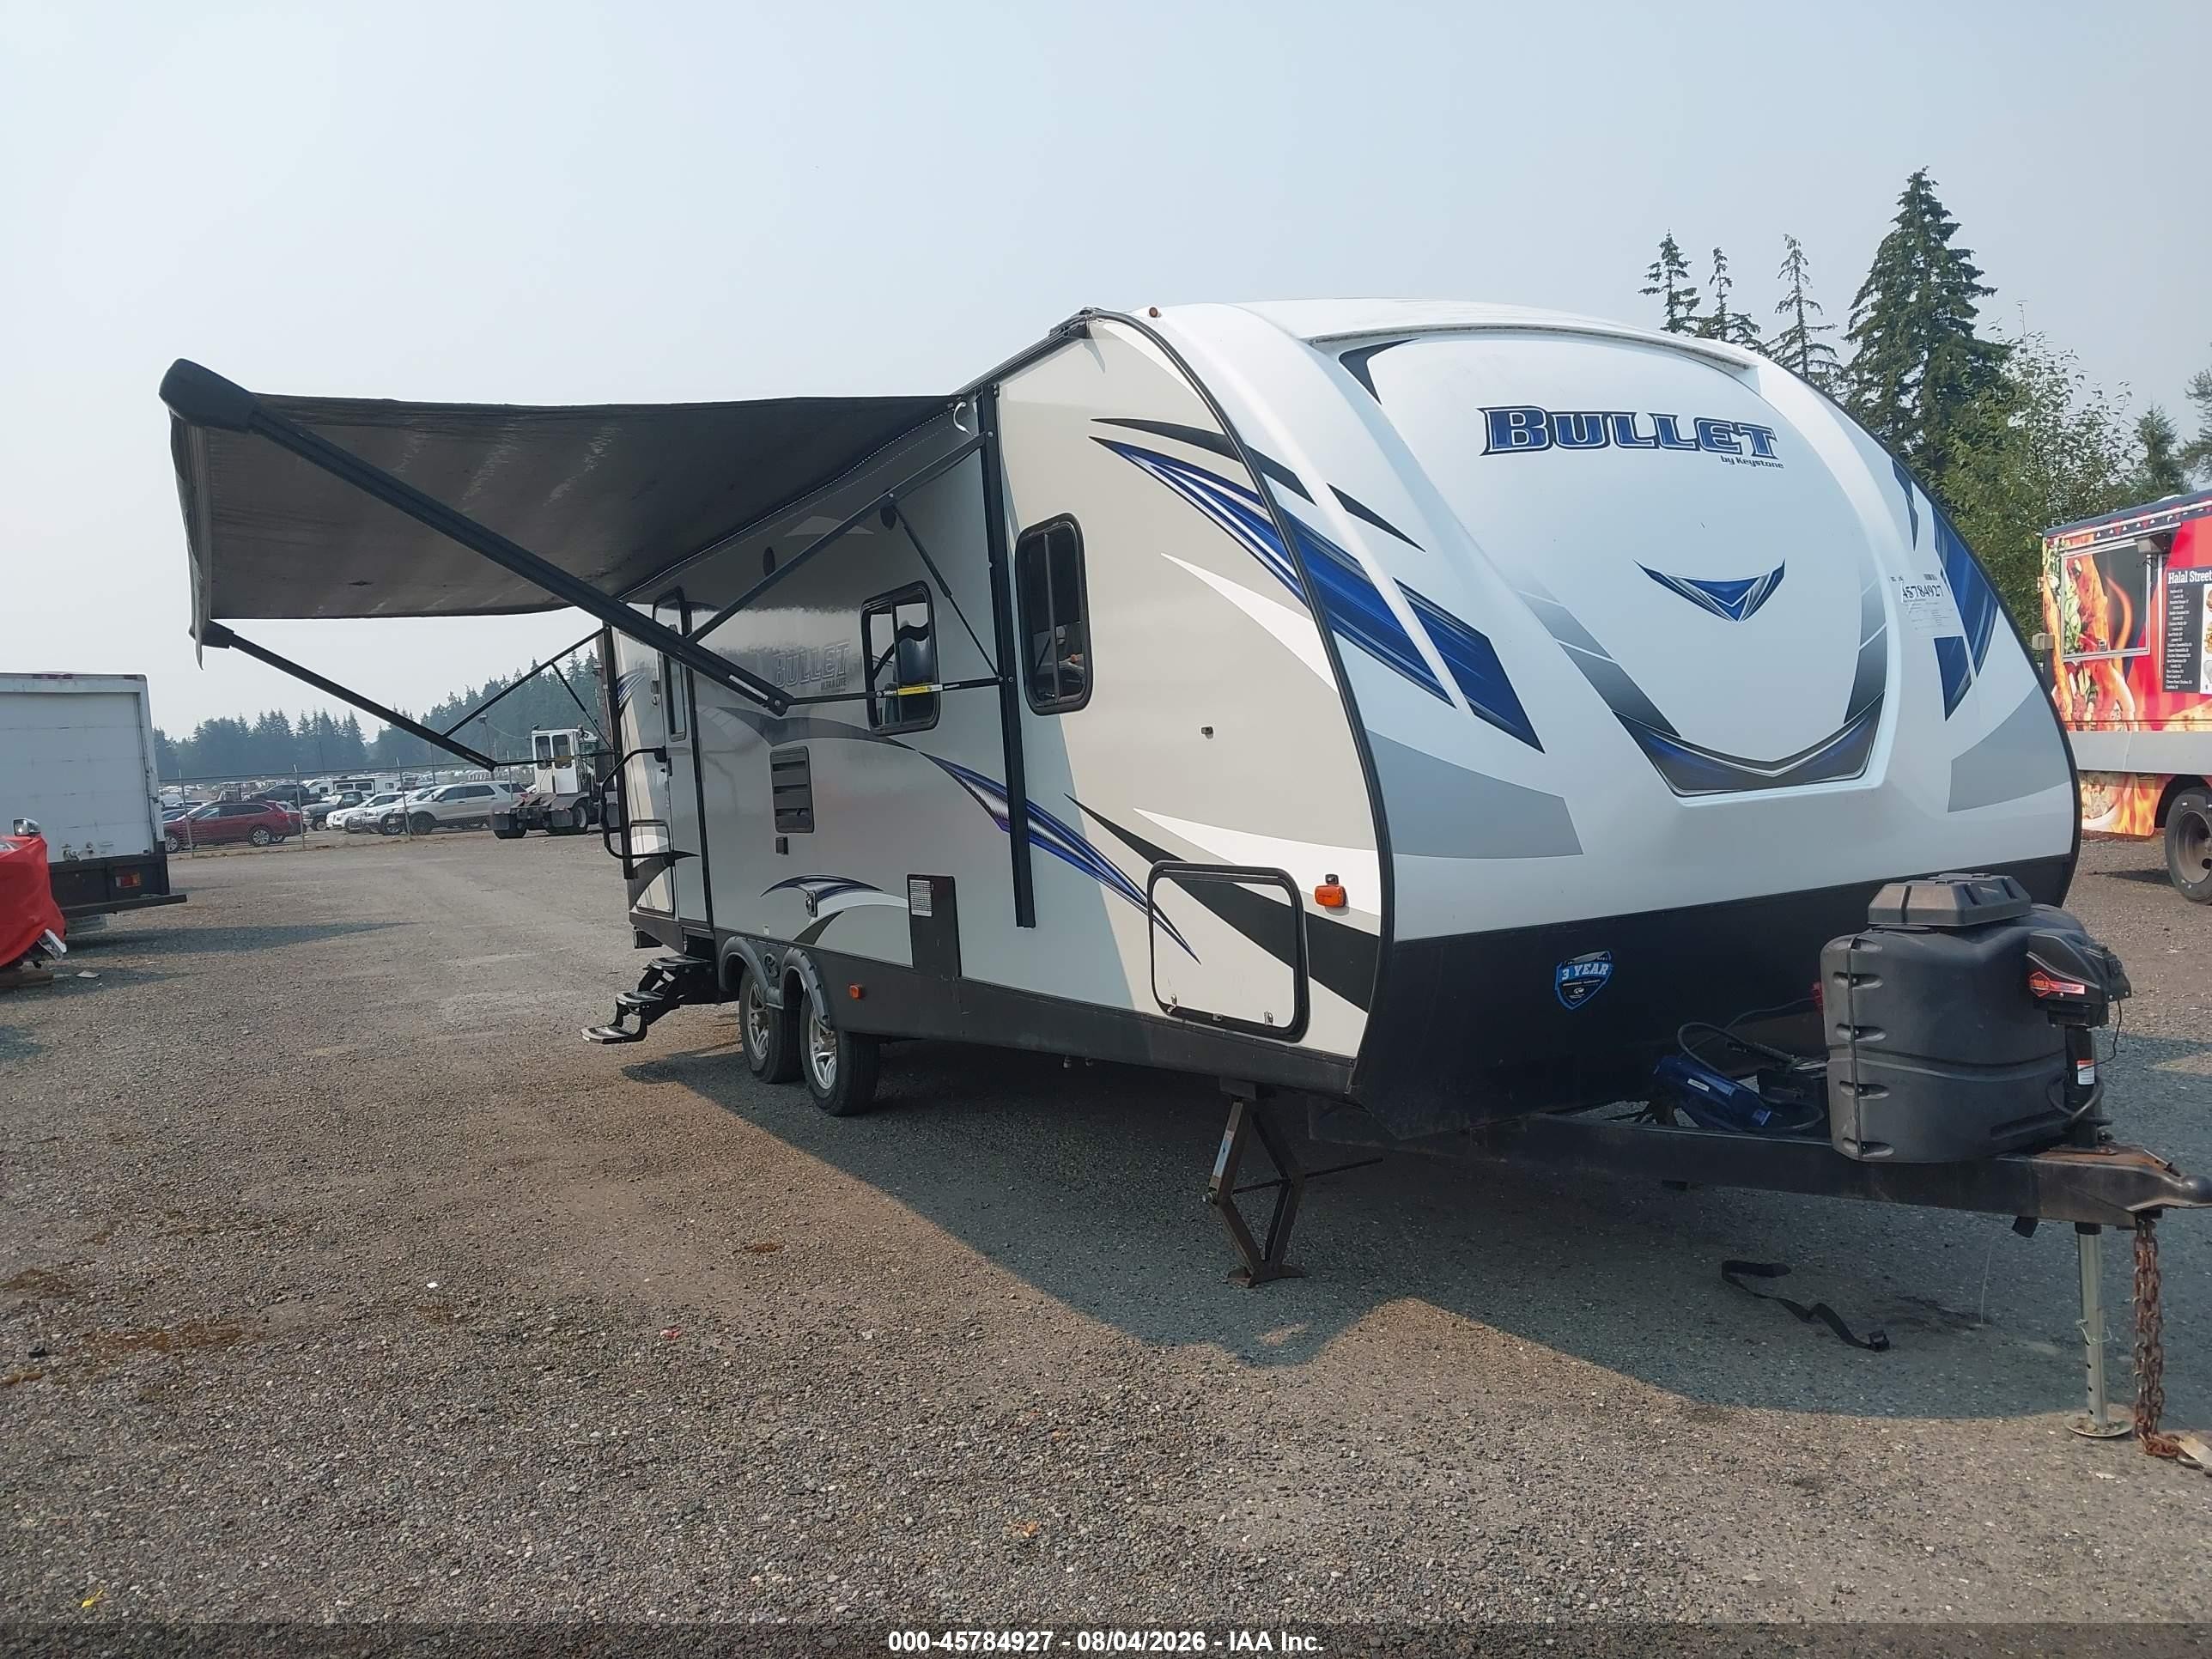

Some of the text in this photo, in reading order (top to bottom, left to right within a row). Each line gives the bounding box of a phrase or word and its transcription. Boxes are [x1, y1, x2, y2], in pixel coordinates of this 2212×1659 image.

[1476, 405, 1779, 459] BULLET
[1720, 455, 1784, 469] by Keystone
[2168, 569, 2212, 585] Halal Street
[1902, 584, 1944, 599] 45784927
[772, 639, 851, 689] BULLET
[1561, 963, 1609, 981] 3 YEAR
